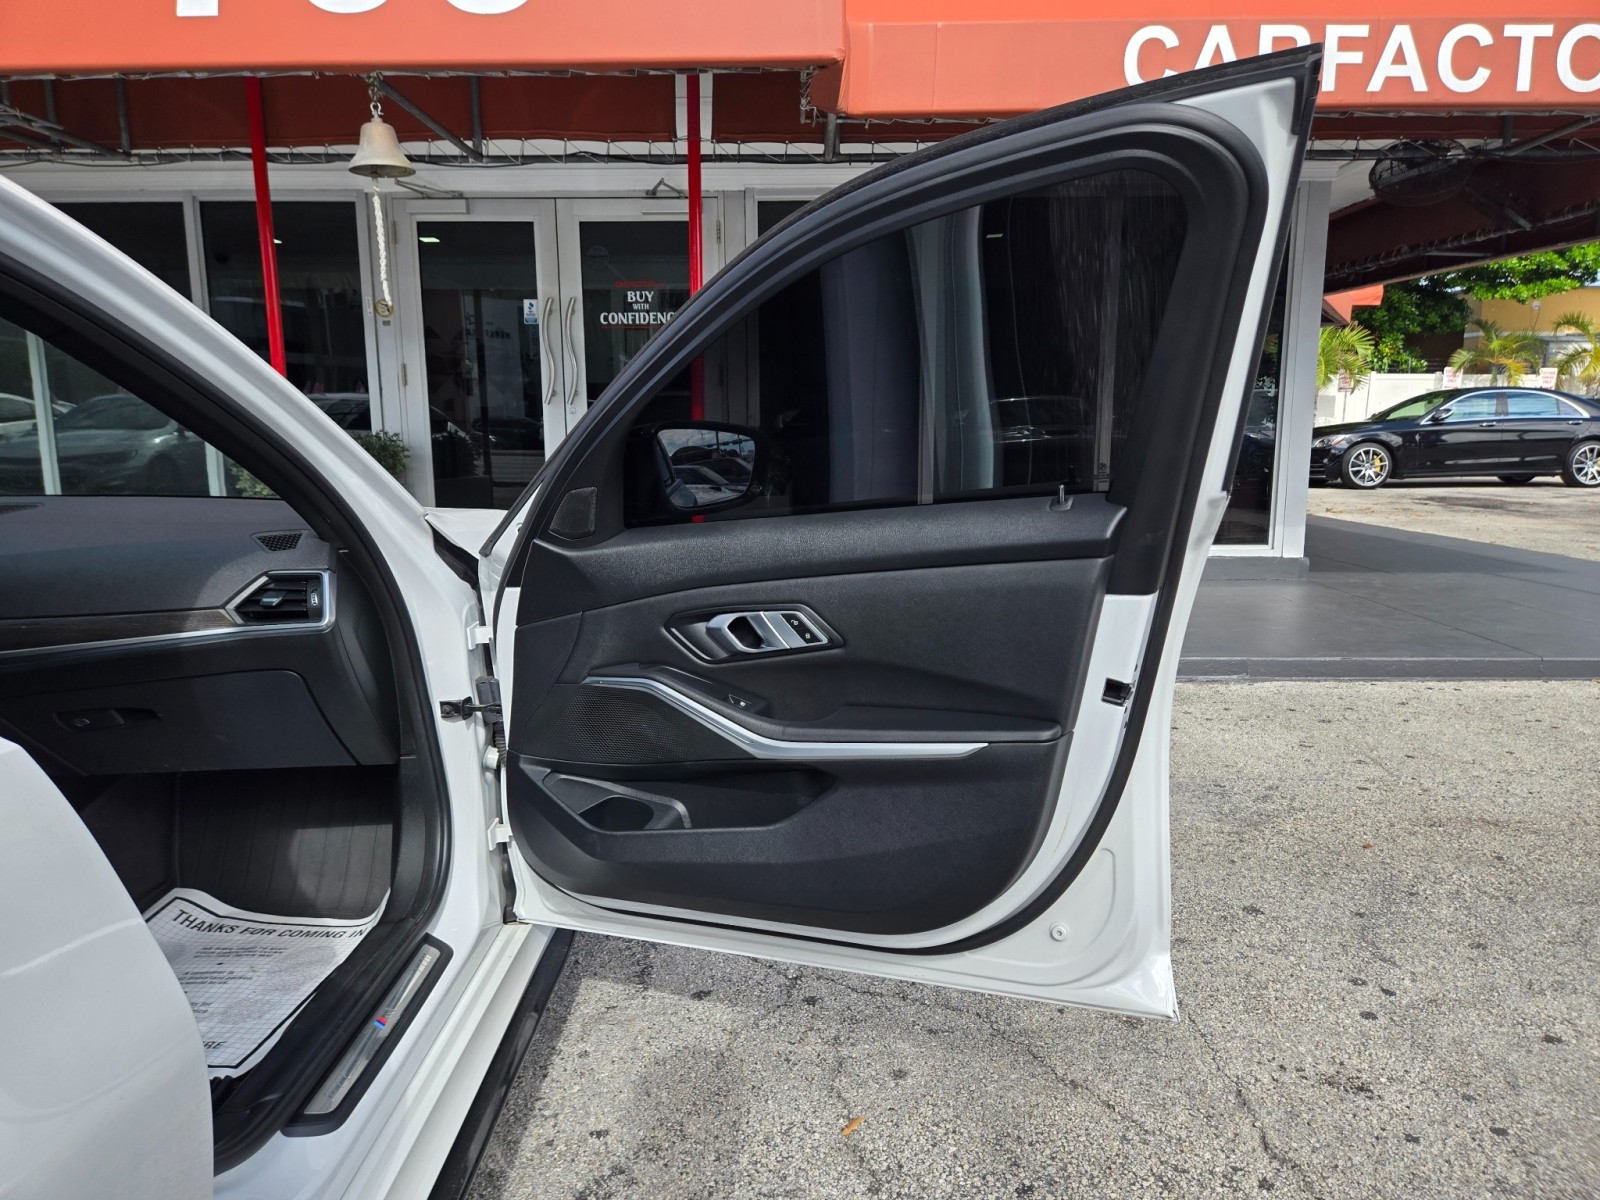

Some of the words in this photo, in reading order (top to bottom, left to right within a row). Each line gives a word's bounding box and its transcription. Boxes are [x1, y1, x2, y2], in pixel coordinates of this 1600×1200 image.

[627, 290, 654, 303] BUY
[173, 909, 240, 934] THANKS
[238, 926, 277, 936] FOR
[277, 929, 347, 939] COMING
[348, 927, 368, 938] IN
